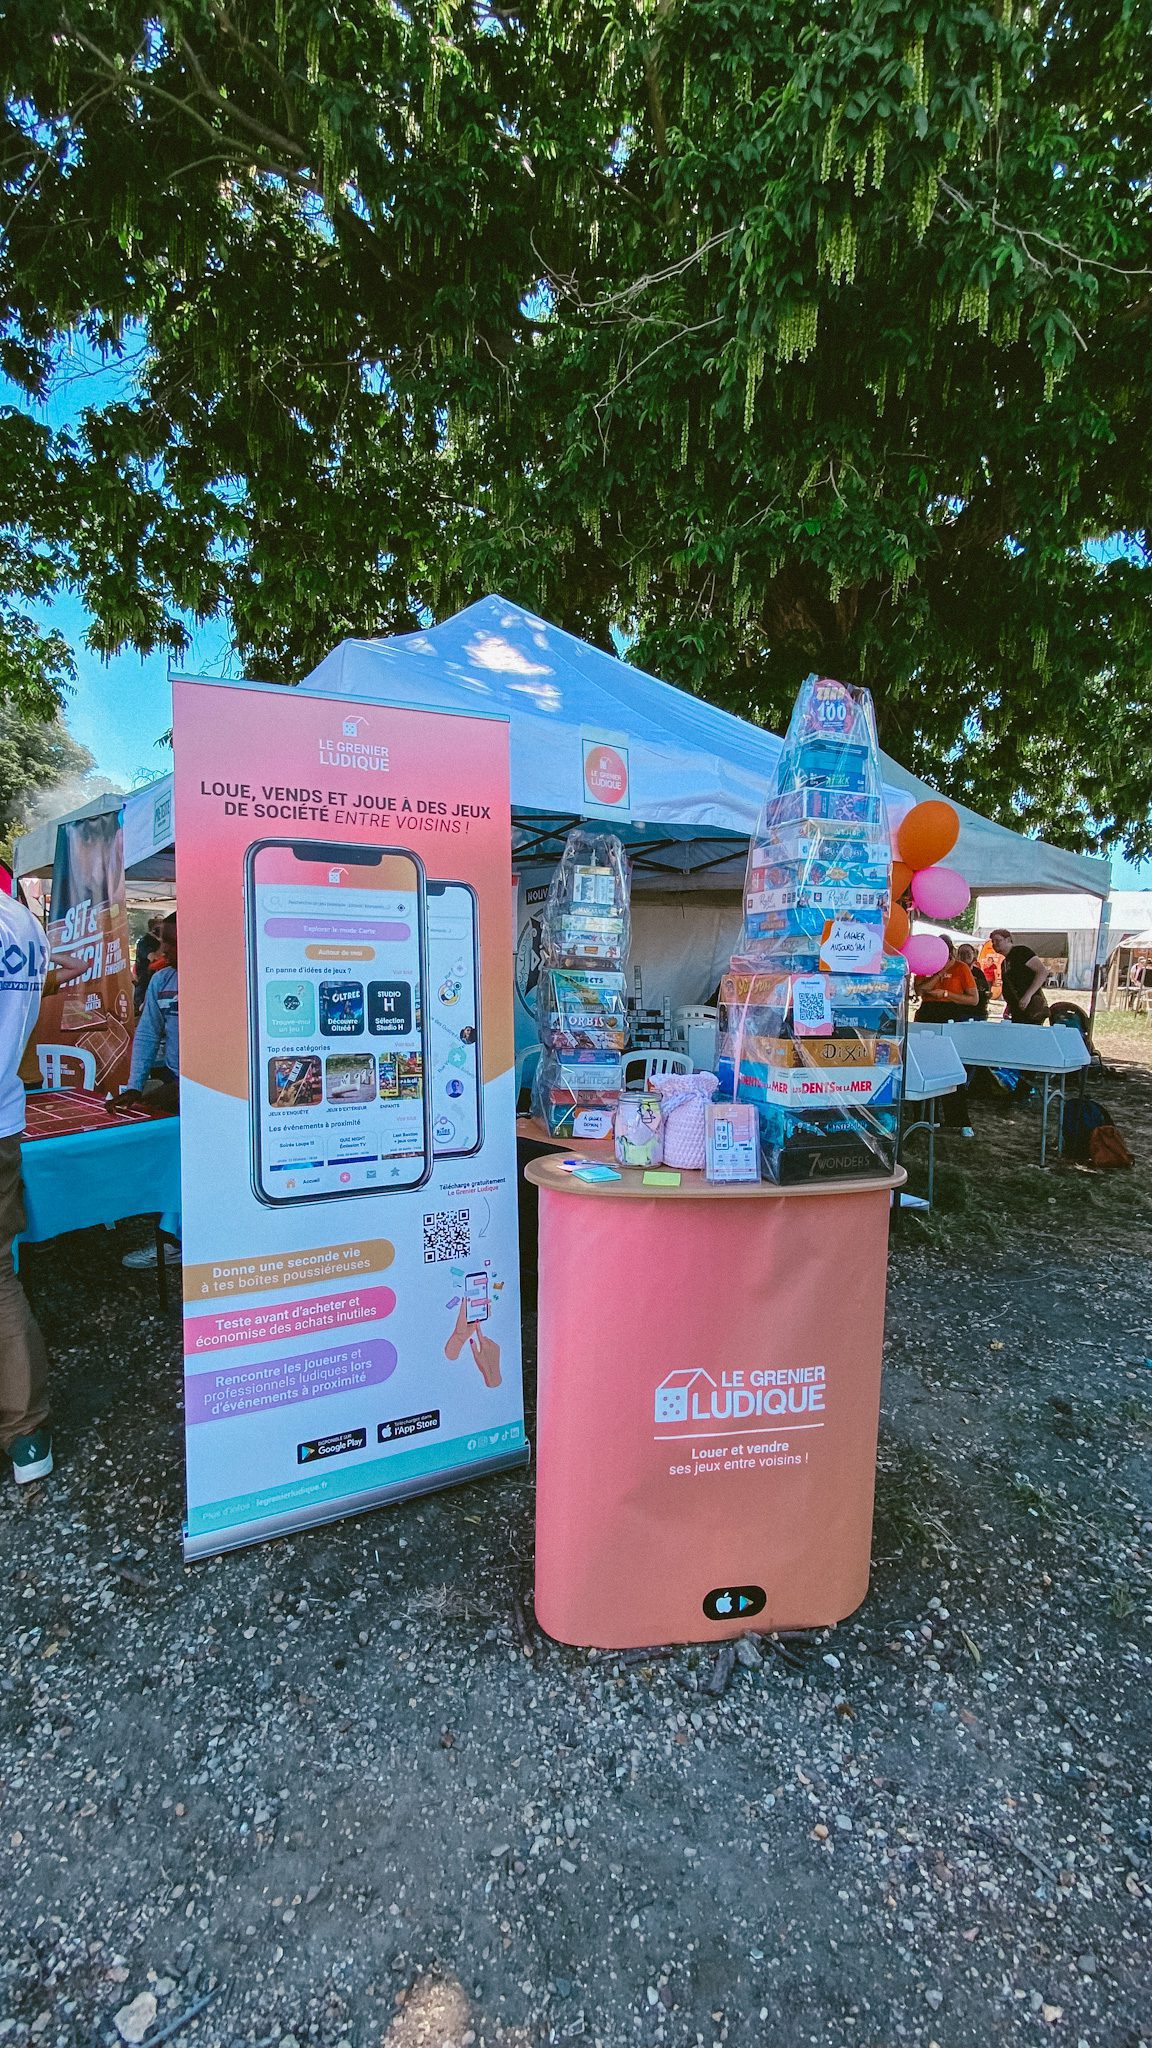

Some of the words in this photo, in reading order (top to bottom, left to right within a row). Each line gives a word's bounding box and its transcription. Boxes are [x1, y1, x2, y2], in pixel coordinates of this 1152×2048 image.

[319, 739, 334, 750] LE
[337, 742, 389, 757] GRENIER
[320, 751, 390, 772] LUDIQUE
[591, 778, 622, 790] LUDIQUE
[201, 781, 256, 801] LOUE,
[262, 786, 323, 803] VENDS
[328, 792, 348, 806] ET
[353, 795, 396, 811] JOUE
[402, 796, 413, 812] À
[417, 800, 447, 815] DES
[452, 804, 491, 819] JEUX
[224, 801, 248, 816] DE
[254, 803, 330, 822] SOCIÉTÉ
[335, 810, 391, 828] ENTRE
[396, 816, 461, 834] VOISINS
[465, 821, 470, 834] !
[61, 899, 92, 942] SET
[88, 907, 98, 932] &
[304, 925, 331, 934] Explorer
[844, 932, 866, 940] GAGNER
[299, 966, 321, 974] d'idées
[378, 990, 401, 998] STUDIO
[384, 998, 394, 1012] H
[568, 1016, 605, 1027] ORBIS
[296, 1044, 330, 1052] catégories
[772, 1081, 788, 1094] MER
[802, 1082, 836, 1094] DENTS
[850, 1081, 872, 1092] MER
[331, 1119, 360, 1128] proximité
[808, 1152, 821, 1176] 7
[818, 1156, 870, 1168] WONDERS
[440, 1182, 470, 1190] Télécharge
[472, 1178, 506, 1188] gratuitement
[456, 1188, 476, 1196] Grenier
[478, 1185, 499, 1194] Ludique
[213, 1265, 255, 1279] Donne
[260, 1262, 284, 1272] une
[288, 1250, 340, 1268] seconde
[342, 1247, 360, 1259] vie
[201, 1282, 209, 1293] à
[214, 1279, 234, 1292] tes
[239, 1273, 279, 1288] boîtes
[216, 1317, 251, 1331] Teste
[255, 1311, 289, 1325] avant
[292, 1299, 346, 1319] d'acheter
[349, 1296, 360, 1306] et
[196, 1328, 266, 1347] économise
[270, 1323, 292, 1336] des
[295, 1314, 334, 1331] achats
[336, 1306, 377, 1322] inutiles
[216, 1367, 280, 1388] Rencontre
[284, 1362, 301, 1374] les
[304, 1353, 348, 1373] joueurs
[351, 1349, 362, 1359] et
[722, 1370, 744, 1388] LE
[750, 1366, 826, 1387] GRENIER
[204, 1377, 296, 1405] professionnels
[300, 1364, 348, 1384] ludiques
[350, 1358, 372, 1371] lors
[212, 1389, 298, 1415] d'événements
[302, 1384, 309, 1396] à
[312, 1372, 366, 1395] proximité
[692, 1384, 826, 1420] LUDIQUE
[394, 1424, 416, 1436] l'App
[416, 1419, 438, 1430] Store
[318, 1436, 342, 1446] DISPONIBLE
[318, 1443, 346, 1455] Google
[347, 1438, 363, 1449] Play
[692, 1448, 728, 1460] Louer
[731, 1445, 744, 1456] et
[747, 1441, 789, 1454] vendre
[670, 1464, 692, 1475] ses
[694, 1461, 720, 1476] jeux
[724, 1458, 756, 1470] entre
[759, 1454, 802, 1467] voisins
[804, 1452, 808, 1464] !
